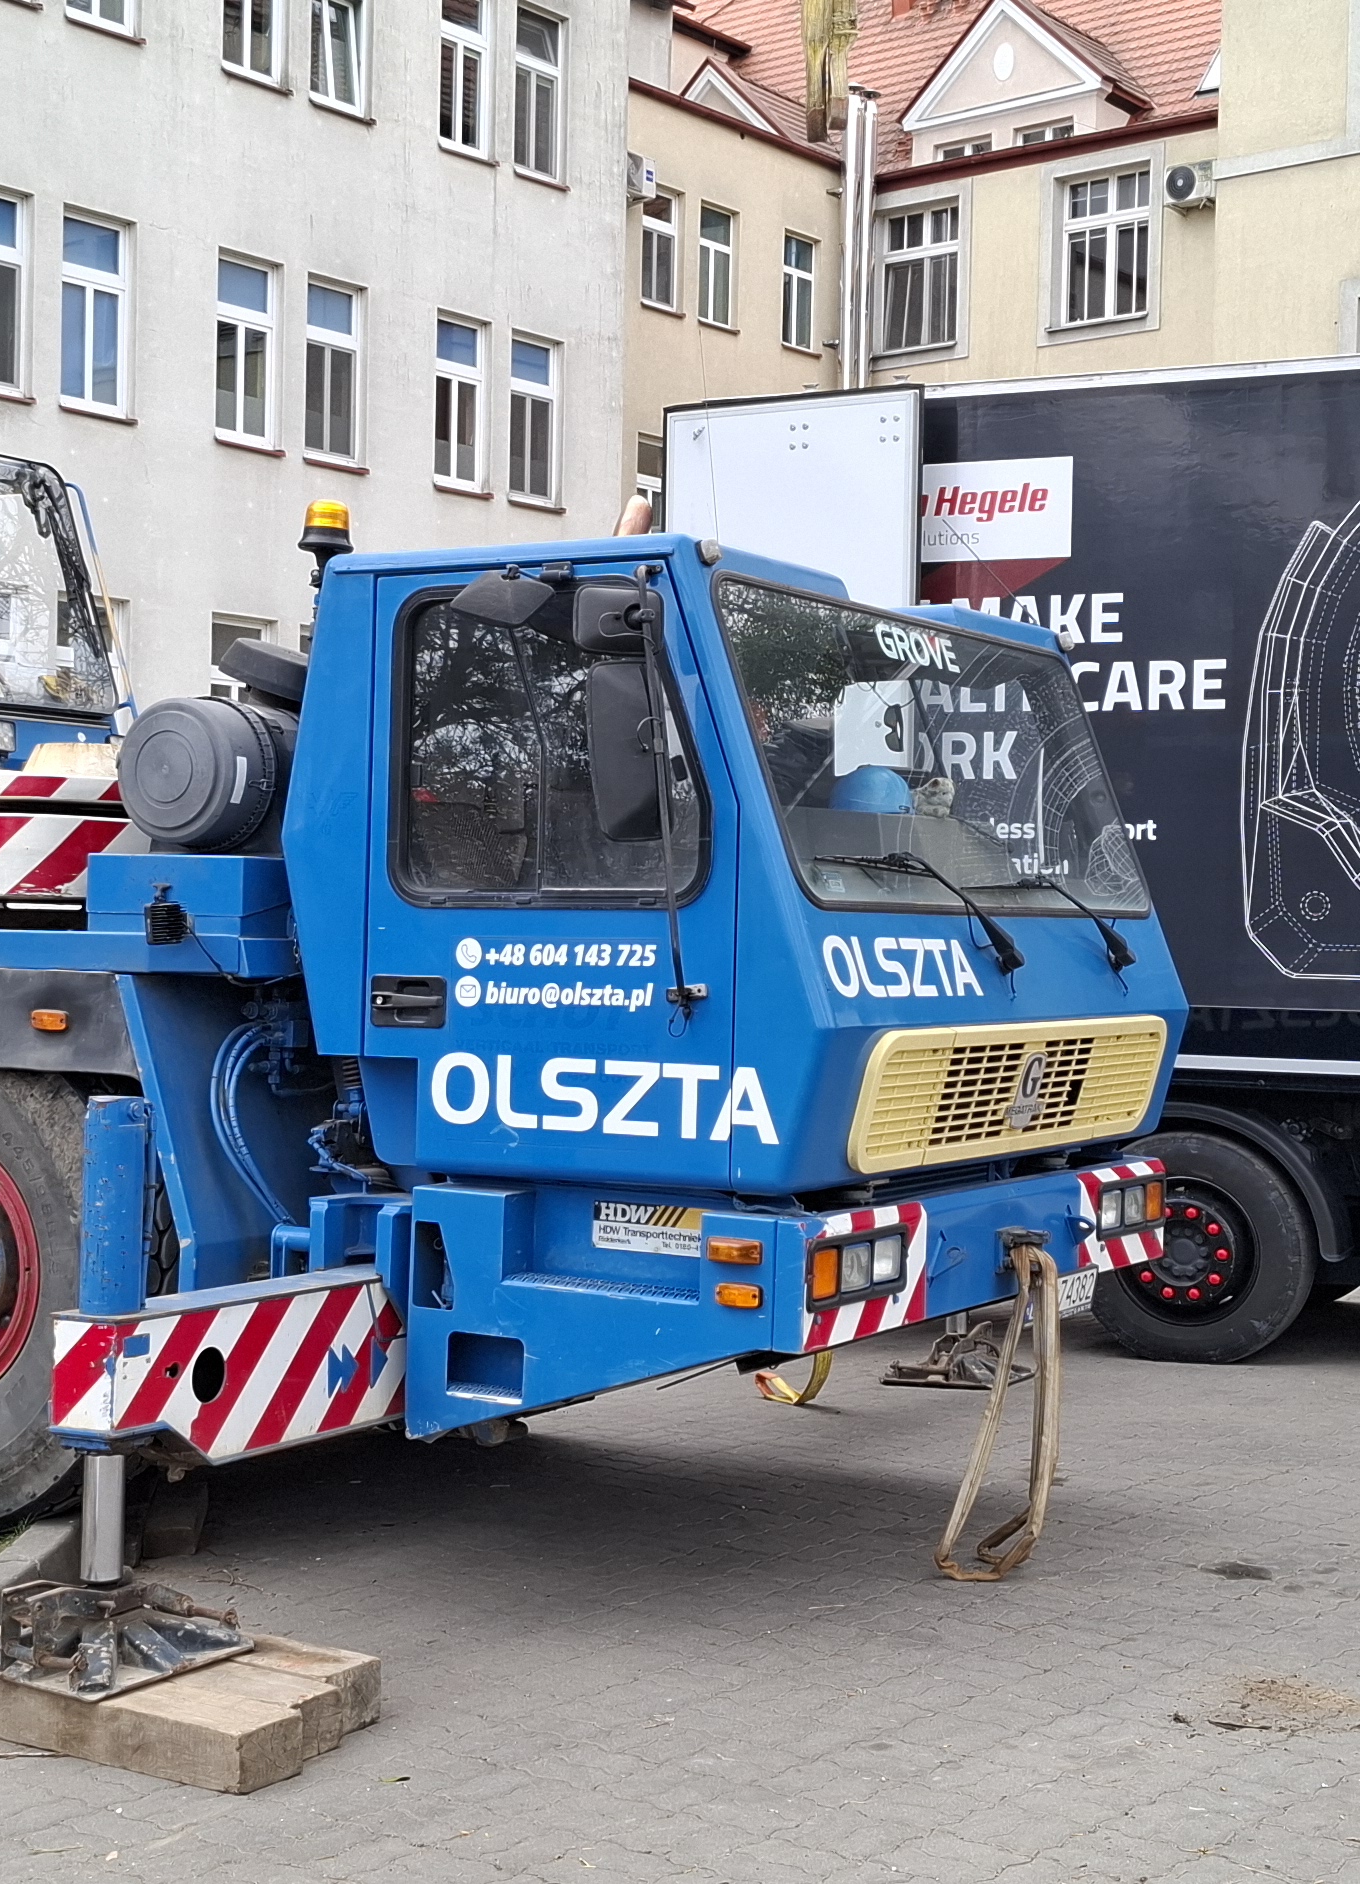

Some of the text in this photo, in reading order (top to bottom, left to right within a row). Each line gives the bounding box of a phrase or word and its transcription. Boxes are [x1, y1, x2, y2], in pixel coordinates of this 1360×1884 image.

[933, 481, 1049, 523] Hegele
[922, 529, 980, 547] lutions
[875, 622, 961, 674] GROVE
[485, 944, 657, 967] +48 604 143 725
[822, 934, 984, 998] OLSZTA
[484, 981, 654, 1011] biuro@olszta.pl
[431, 1051, 780, 1145] OLSZTA
[600, 1202, 654, 1223] HDW
[599, 1225, 621, 1236] HDW
